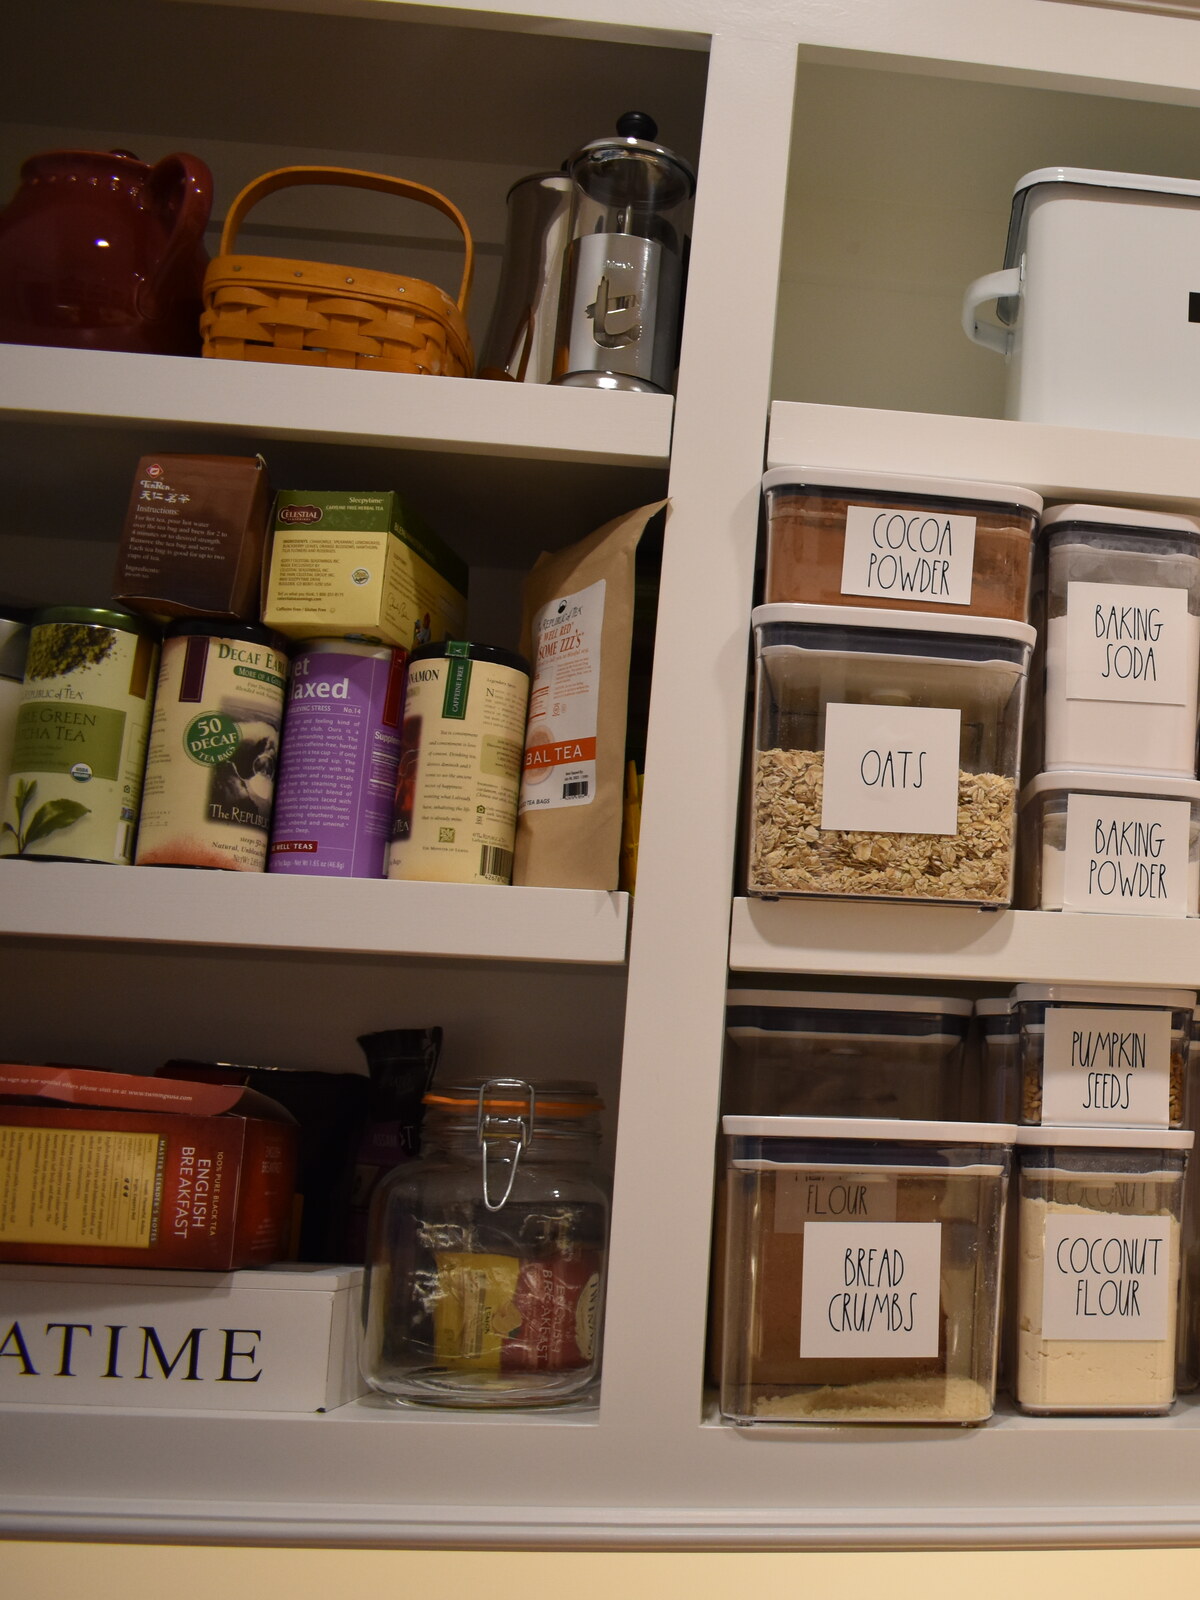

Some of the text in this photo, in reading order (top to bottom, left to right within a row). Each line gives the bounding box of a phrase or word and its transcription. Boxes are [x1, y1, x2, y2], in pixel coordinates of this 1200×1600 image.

[281, 510, 319, 520] CELESTIAL
[872, 513, 953, 556] COCOA
[868, 553, 951, 596] POWDER
[560, 622, 572, 636] RED
[1095, 604, 1164, 642] BAKING
[218, 644, 261, 665] DECAF
[1102, 643, 1157, 682] SODA
[452, 665, 464, 712] CAFFEINE FREE
[40, 708, 97, 726] GREEN
[56, 726, 86, 742] TEA
[198, 718, 222, 737] 50
[190, 732, 237, 752] DECAF
[199, 745, 236, 762] TEA BAGS
[554, 744, 582, 760] TEA
[860, 749, 927, 788] OATS
[209, 804, 230, 820] The
[1095, 819, 1165, 858] BAKING
[1089, 860, 1168, 899] POWDER
[1072, 1031, 1146, 1069] PUMPKIN
[1083, 1072, 1133, 1110] SEEDS
[158, 1140, 166, 1170] MASTER
[216, 1151, 224, 1172] 100%
[174, 1146, 196, 1238] BREAKFAST
[192, 1158, 212, 1228] ENGLISH
[213, 1174, 222, 1192] PURE
[807, 1185, 868, 1215] FLOUR
[211, 1195, 220, 1220] BLACK
[150, 1217, 158, 1242] NOTES
[845, 1248, 905, 1287] BREAD
[1057, 1238, 1164, 1275] COCONUT
[536, 1270, 552, 1360] BREAKFAST
[828, 1293, 918, 1332] CRUMBS
[1076, 1280, 1141, 1317] FLOUR
[0, 1320, 263, 1382] ATIME
